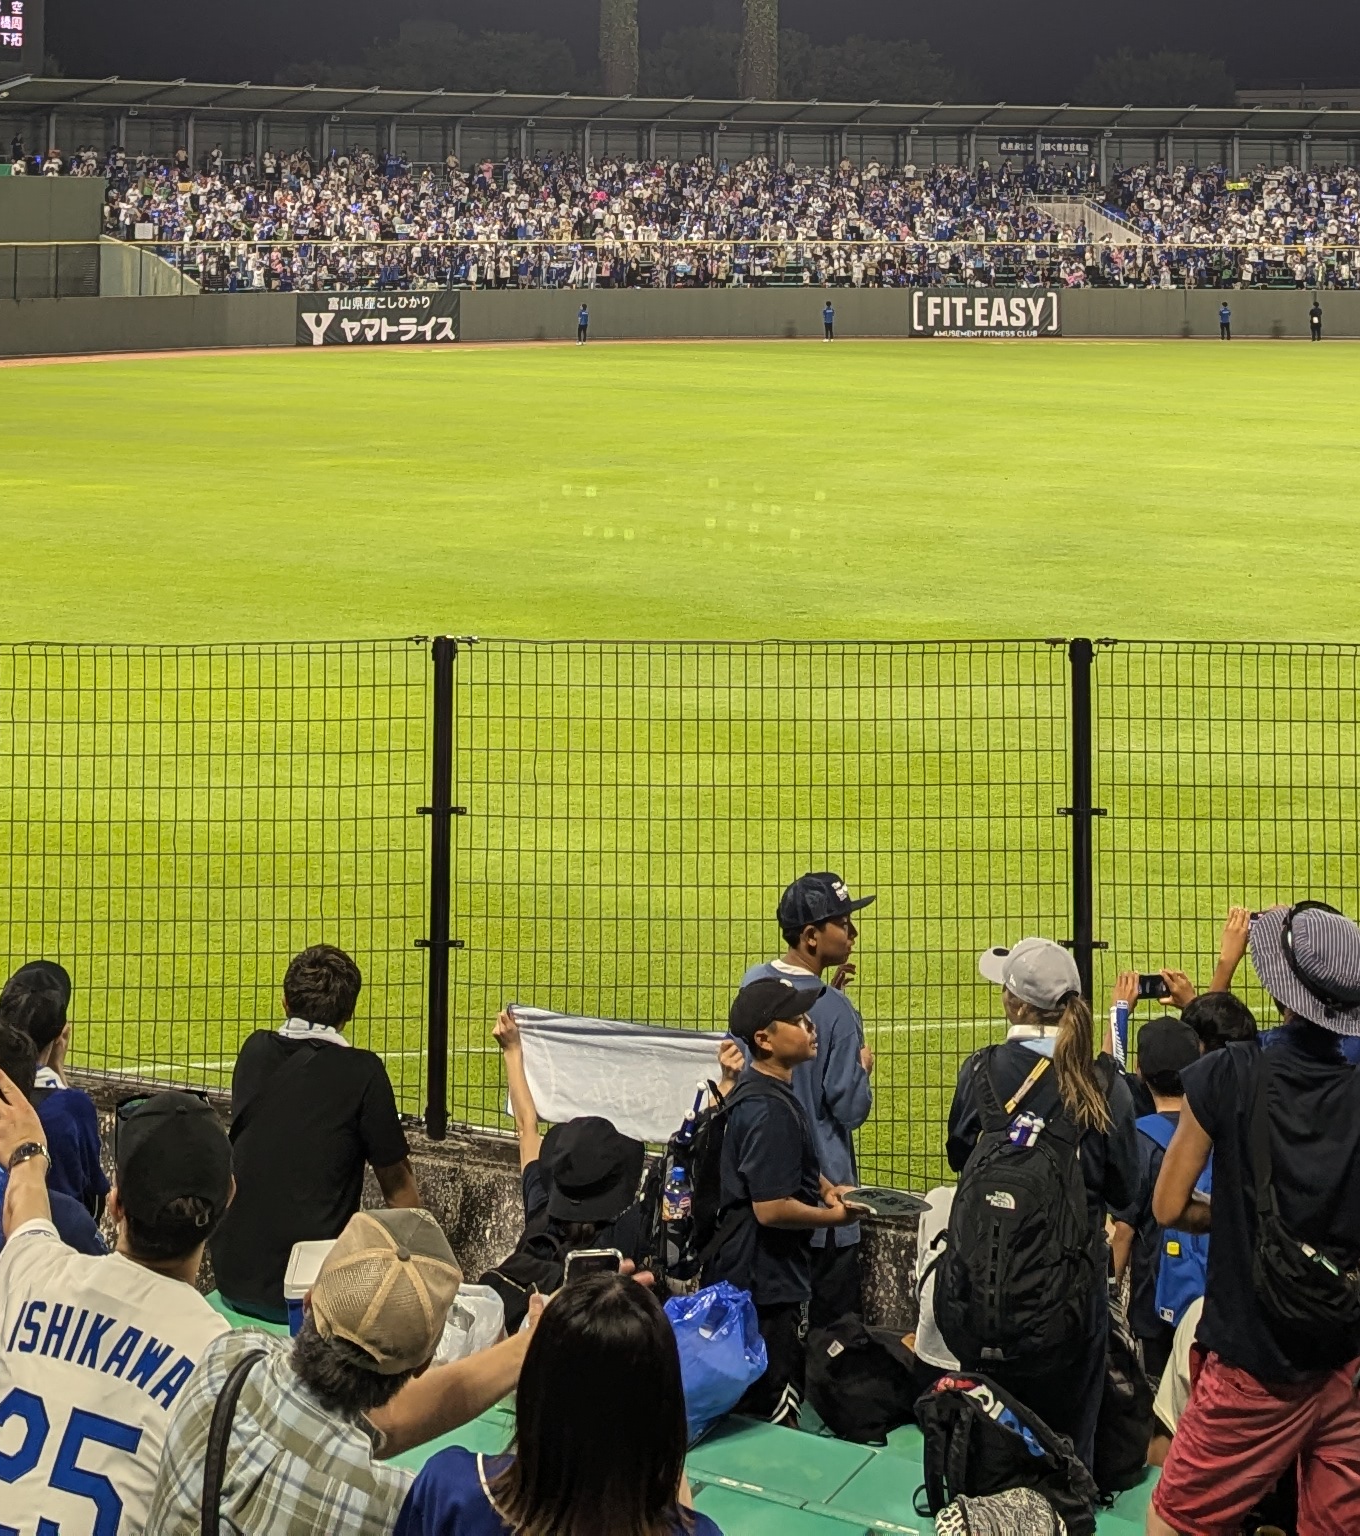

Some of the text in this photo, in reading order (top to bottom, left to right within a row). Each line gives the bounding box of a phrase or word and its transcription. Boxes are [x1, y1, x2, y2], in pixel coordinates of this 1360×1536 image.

[328, 296, 431, 311] 富山県産こしひかり
[340, 316, 455, 343] ヤマトライス
[933, 330, 1038, 338] AMUSEMENT FITNESS CLUB
[6, 1300, 196, 1412] ISHIKAWA
